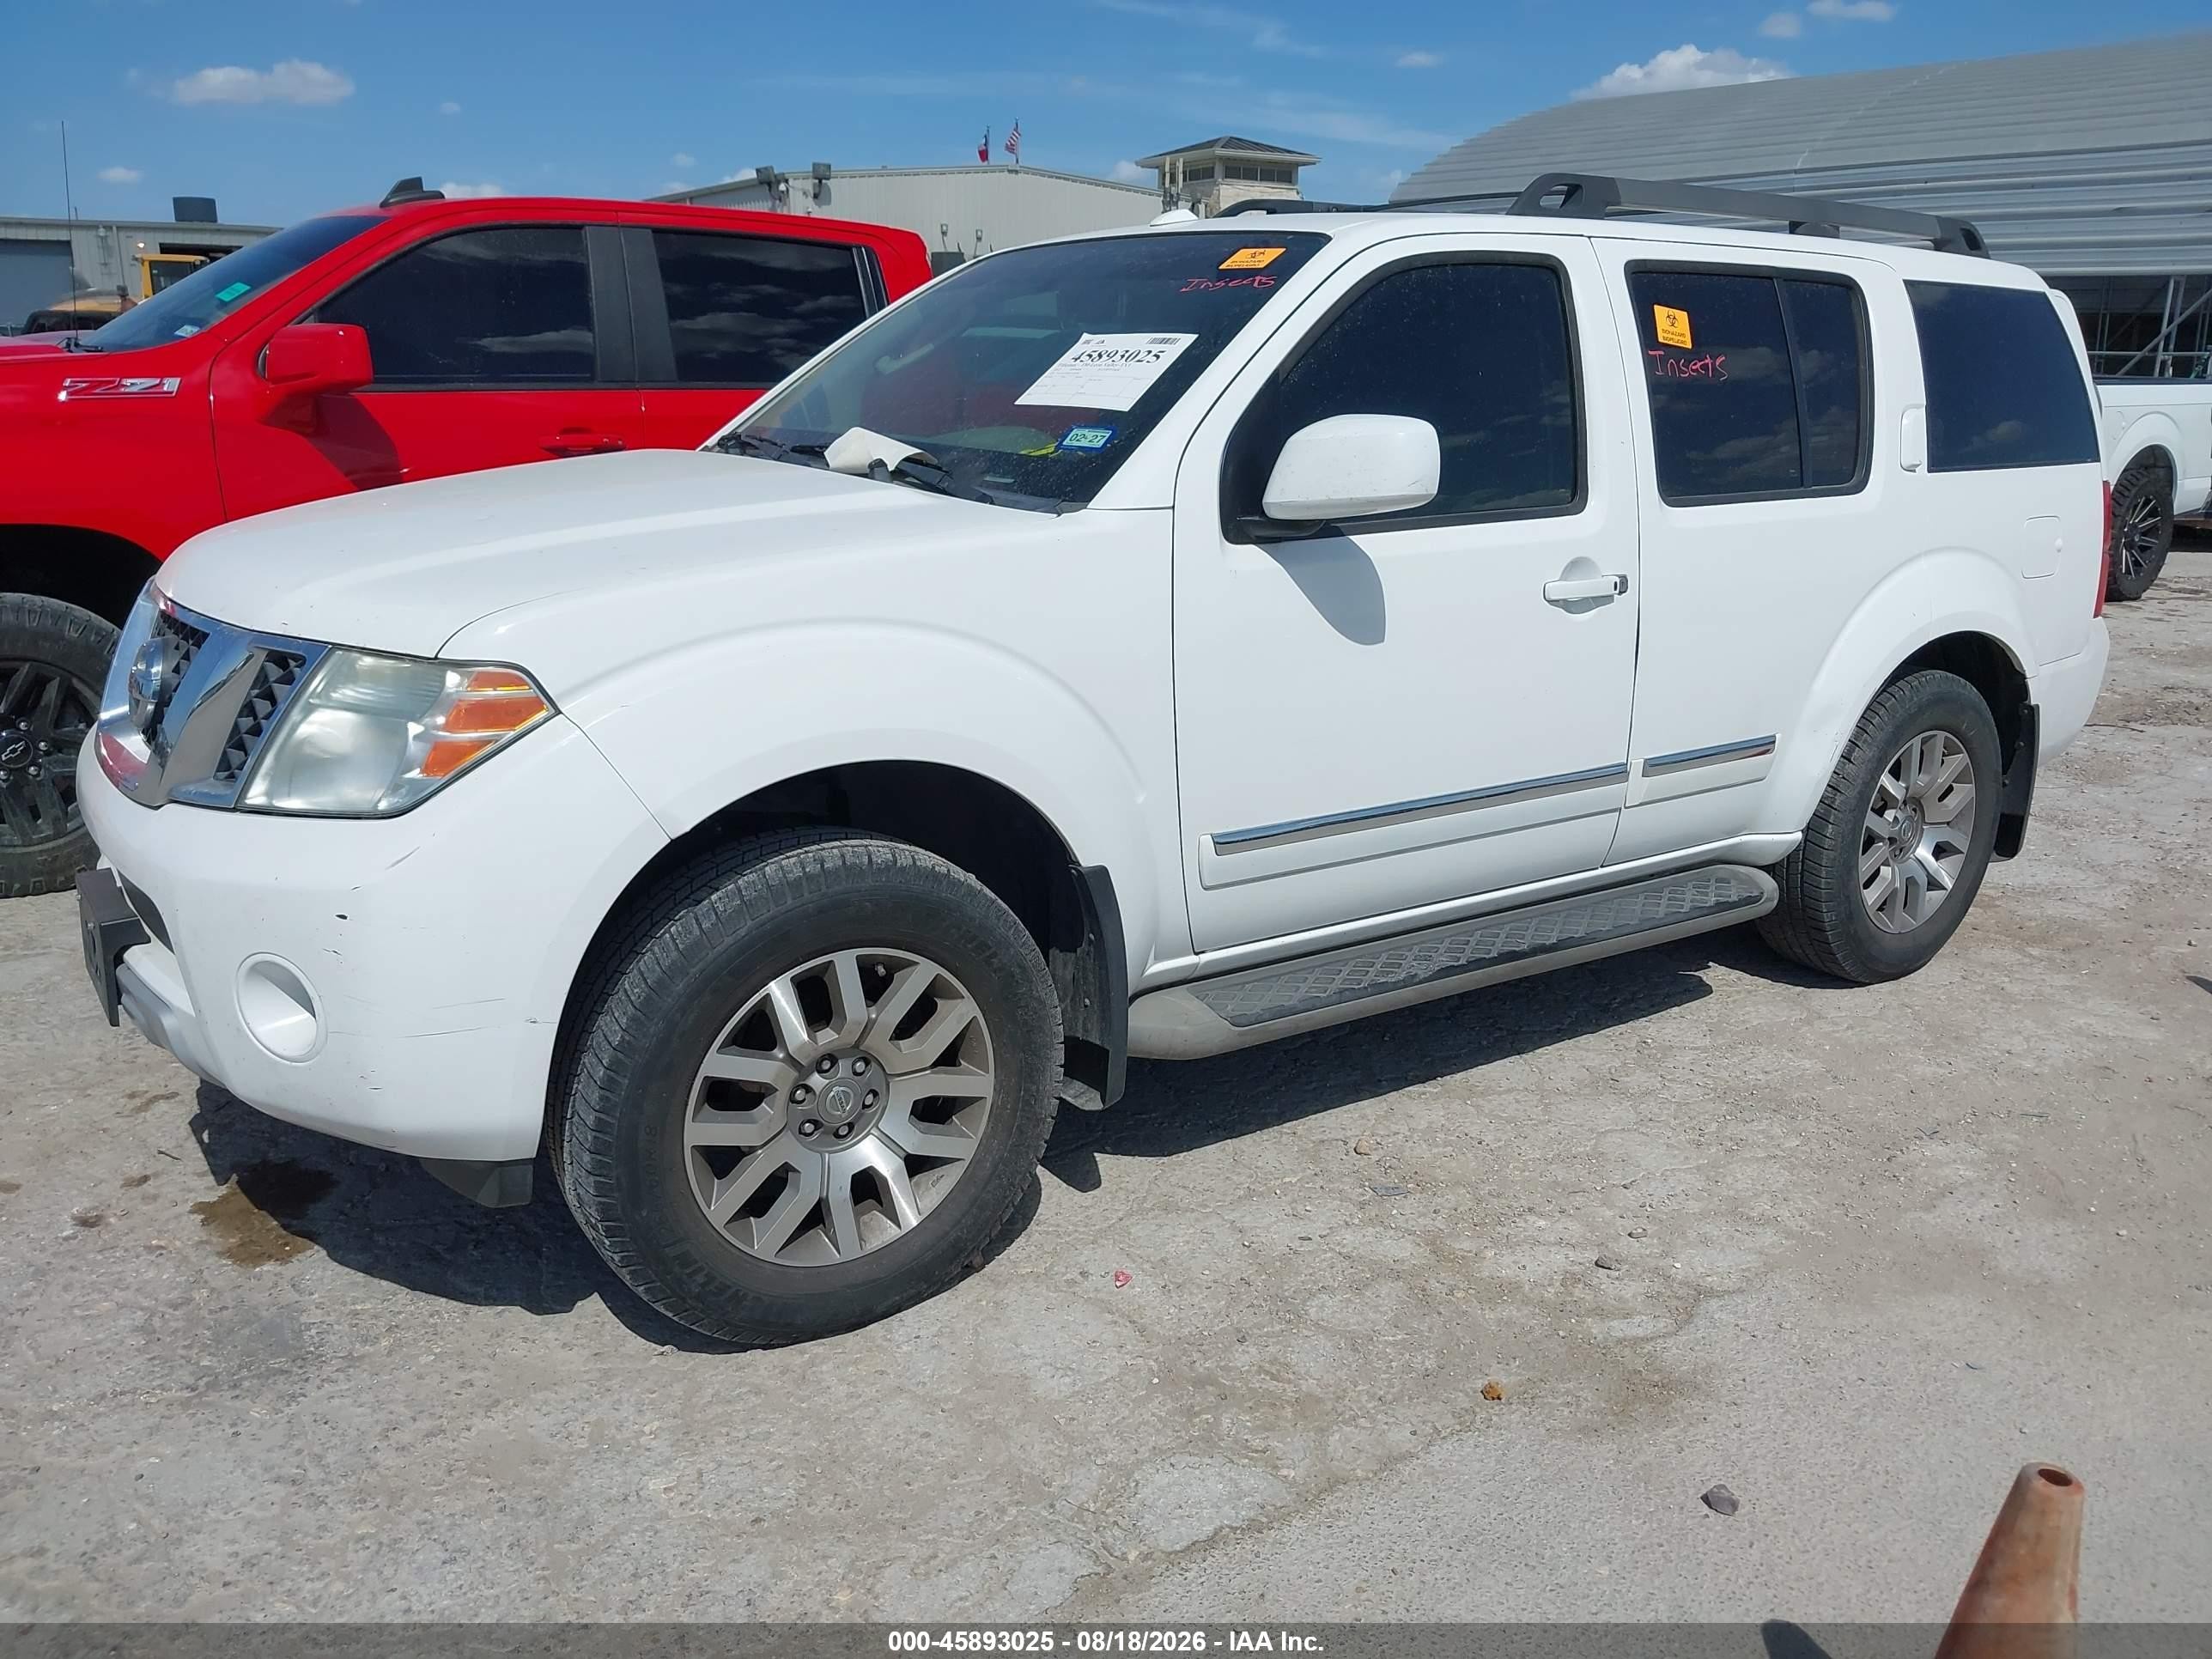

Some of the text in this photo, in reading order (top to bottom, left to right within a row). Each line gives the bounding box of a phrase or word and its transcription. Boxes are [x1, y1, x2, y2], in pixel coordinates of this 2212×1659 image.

[1180, 276, 1278, 292] Insects
[1072, 349, 1167, 364] 45893025
[1648, 350, 1729, 381] Insects
[58, 377, 181, 402] Z71
[1069, 433, 1107, 443] 02 27
